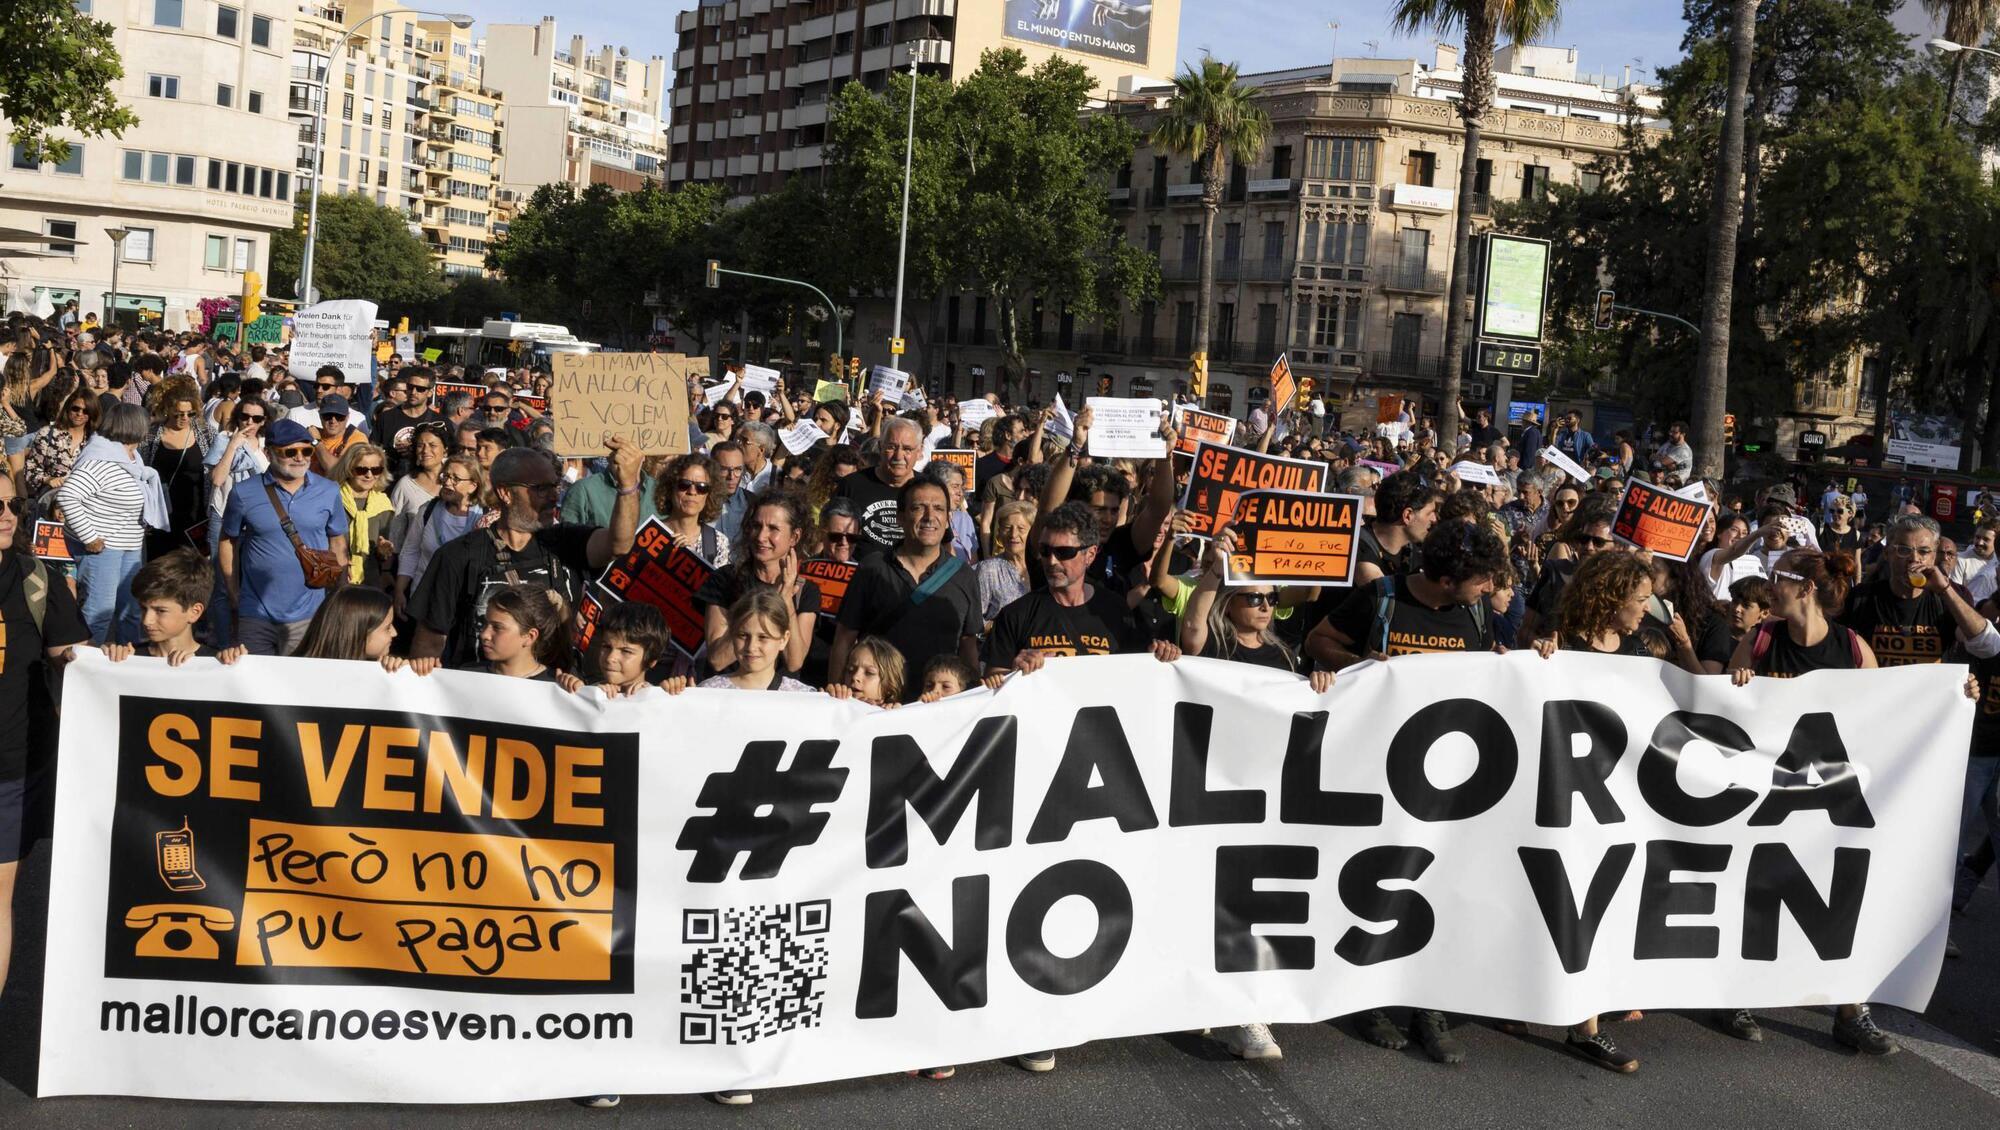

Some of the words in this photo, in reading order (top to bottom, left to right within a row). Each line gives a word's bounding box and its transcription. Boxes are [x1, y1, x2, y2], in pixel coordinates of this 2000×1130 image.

[1017, 20, 1029, 31] EL
[1030, 24, 1069, 39] MUNDO
[1068, 31, 1083, 42] EN
[1083, 34, 1102, 47] TUS
[1102, 40, 1136, 54] MANOS
[206, 199, 226, 208] HOTEL
[297, 312, 320, 320] Vielen
[321, 312, 341, 320] Dank
[343, 313, 353, 321] für
[297, 321, 314, 329] Ihren
[316, 322, 345, 330] Besuch!
[248, 330, 280, 342] ARRUIX
[296, 341, 320, 350] darauf,
[322, 341, 334, 349] Sie
[297, 331, 308, 339] Wir
[310, 331, 333, 340] freuen
[333, 333, 347, 341] uns
[348, 333, 370, 341] schon
[436, 385, 447, 397] SE
[559, 371, 673, 401] MALLORCA
[591, 401, 669, 426] VOLEM
[1194, 414, 1231, 434] VENDE
[1803, 433, 1824, 445] GOIKO
[946, 454, 974, 466] VENDE
[1199, 449, 1228, 482] SE
[1229, 457, 1318, 493] ALQUILA
[1236, 496, 1260, 525] SE
[1263, 499, 1352, 529] ALQUILA
[1628, 487, 1650, 509] SE
[1648, 495, 1704, 525] ALQUILA
[38, 524, 50, 537] SE
[863, 525, 893, 546] BROOKLYN
[1263, 537, 1273, 549] I
[1286, 538, 1305, 550] NO
[637, 526, 670, 559] SE
[664, 544, 711, 590] VEN
[1273, 557, 1326, 572] PAGAR
[806, 561, 857, 581] VENDE
[580, 599, 597, 621] SE
[1030, 634, 1110, 649] MALLRCA
[1389, 631, 1466, 649] MALLORCA
[1876, 636, 1905, 651] NO
[1913, 638, 1937, 652] ES
[144, 712, 263, 802] SE
[296, 721, 605, 827] VENDE
[675, 697, 1876, 884] #MALLORCA
[252, 832, 389, 888] Però
[413, 848, 488, 892] no
[520, 844, 602, 902] ho
[855, 858, 1134, 1020] NO
[1214, 844, 1436, 974] ES
[1517, 839, 1871, 975] VEN
[256, 909, 363, 968] puc
[397, 913, 580, 976] pagar
[99, 994, 634, 1041] mallorcanoesven.com
